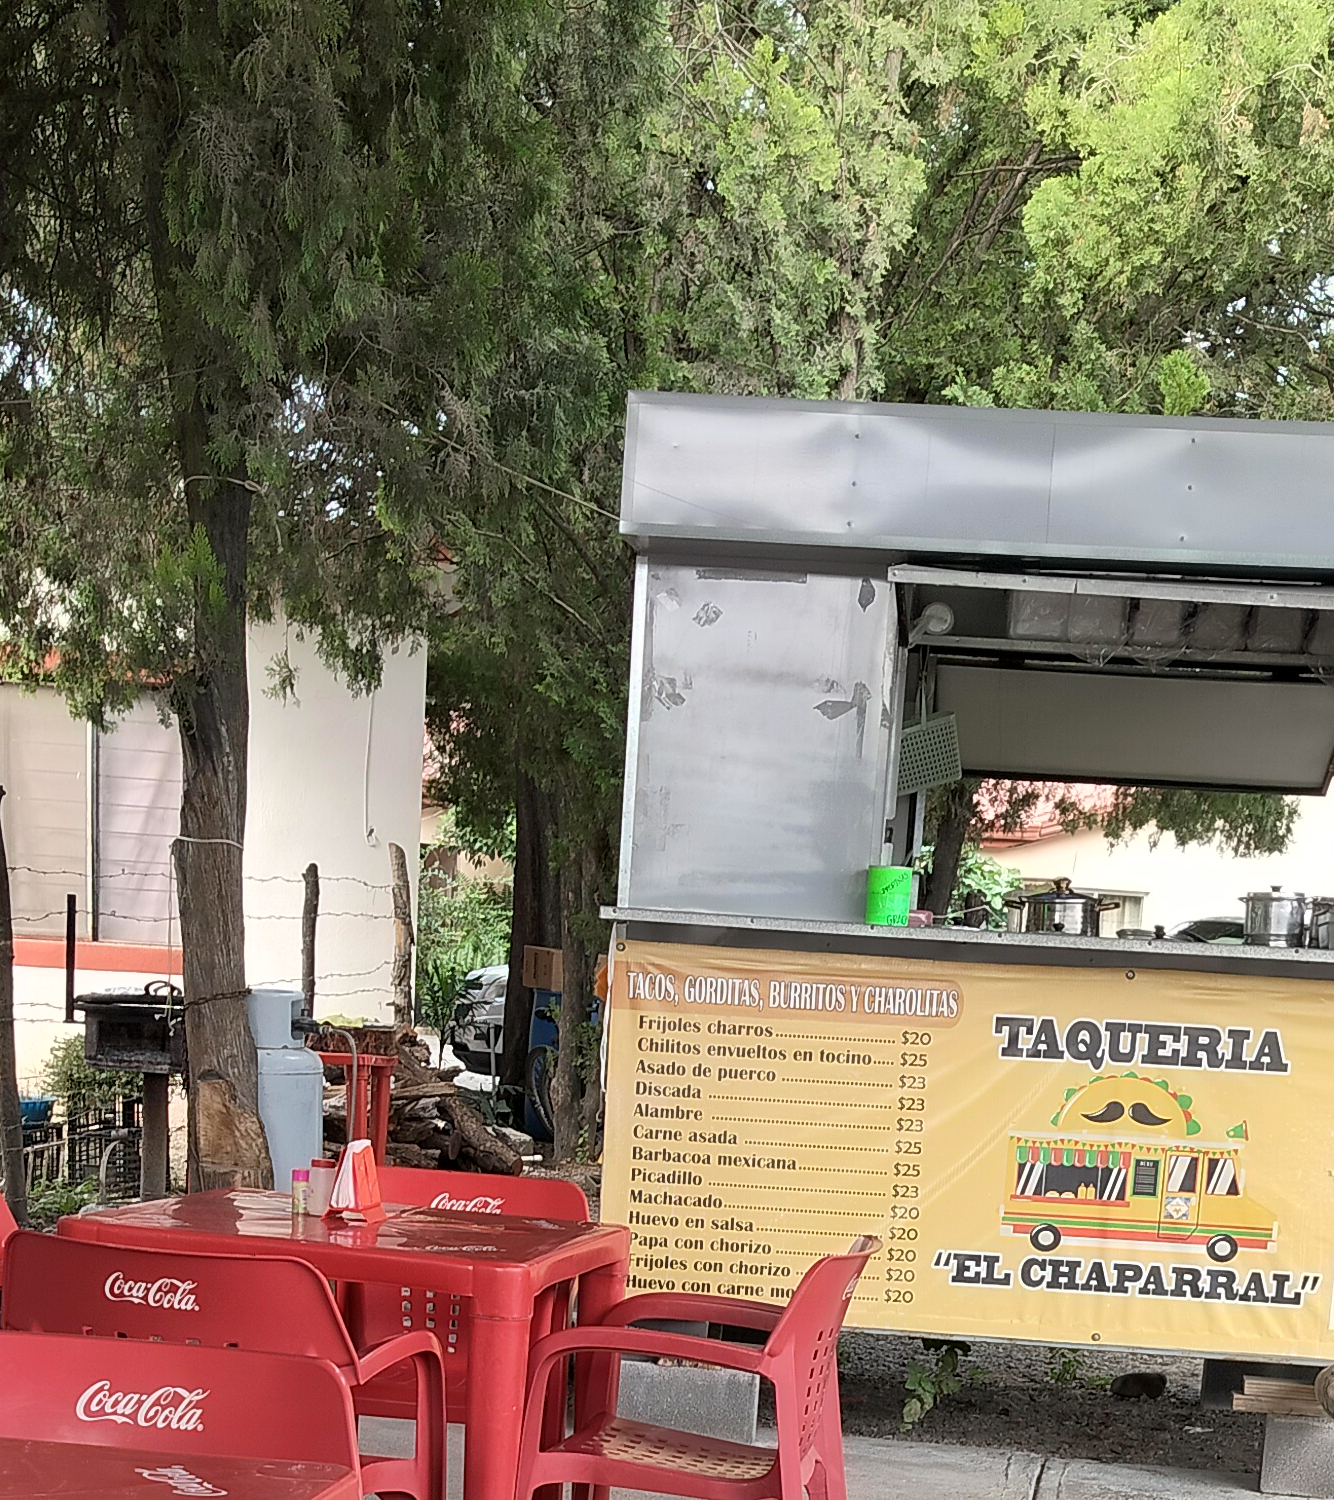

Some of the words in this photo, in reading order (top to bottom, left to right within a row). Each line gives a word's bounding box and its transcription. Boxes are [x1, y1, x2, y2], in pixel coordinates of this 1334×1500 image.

[627, 971, 679, 1006] TACOS,
[684, 975, 764, 1011] GORDITAS,
[769, 980, 846, 1013] BURRITOS
[849, 985, 862, 1013] Y
[863, 986, 959, 1018] CHAROLITAS
[638, 1015, 702, 1034] Frijoles
[707, 1020, 774, 1038] charros
[900, 1029, 933, 1047] $20
[994, 1016, 1288, 1073] TAQUERIA
[637, 1037, 702, 1056] Chilitos
[707, 1043, 787, 1062] envueltos
[792, 1048, 813, 1063] en
[819, 1049, 873, 1066] tocino
[899, 1051, 928, 1069] $25
[635, 1059, 687, 1078] Asado
[691, 1061, 712, 1078] de
[717, 1065, 777, 1083] puerco
[897, 1074, 927, 1091] $23
[635, 1081, 702, 1100] Discada
[896, 1096, 926, 1113] $23
[633, 1102, 703, 1121] Alambre
[895, 1117, 925, 1134] $23
[632, 1124, 683, 1142] Carne
[688, 1128, 738, 1145] asada
[894, 1139, 923, 1156] $25
[631, 1145, 711, 1166] Barbacoa
[717, 1153, 797, 1171] mexicana
[892, 1161, 921, 1179] $25
[630, 1167, 703, 1187] Picadillo
[890, 1183, 920, 1200] $23
[629, 1188, 723, 1210] Machacado
[889, 1205, 920, 1222] $20
[628, 1210, 679, 1229] Huevo
[685, 1215, 705, 1230] en
[710, 1216, 754, 1233] salsa
[887, 1226, 919, 1243] $20
[629, 1232, 668, 1250] Papa
[674, 1236, 704, 1250] con
[710, 1236, 772, 1255] chorizo
[886, 1247, 917, 1264] $20
[629, 1253, 688, 1271] Frijoles
[693, 1259, 723, 1273] con
[729, 1260, 791, 1277] chorizo
[885, 1267, 916, 1284] $20
[104, 1270, 199, 1312] Coca-Cola
[626, 1274, 676, 1291] Huevo
[681, 1280, 711, 1293] con
[717, 1282, 764, 1297] carne
[770, 1287, 796, 1299] mo
[883, 1288, 914, 1304] $20
[75, 1380, 204, 1432] Coca-Cola
